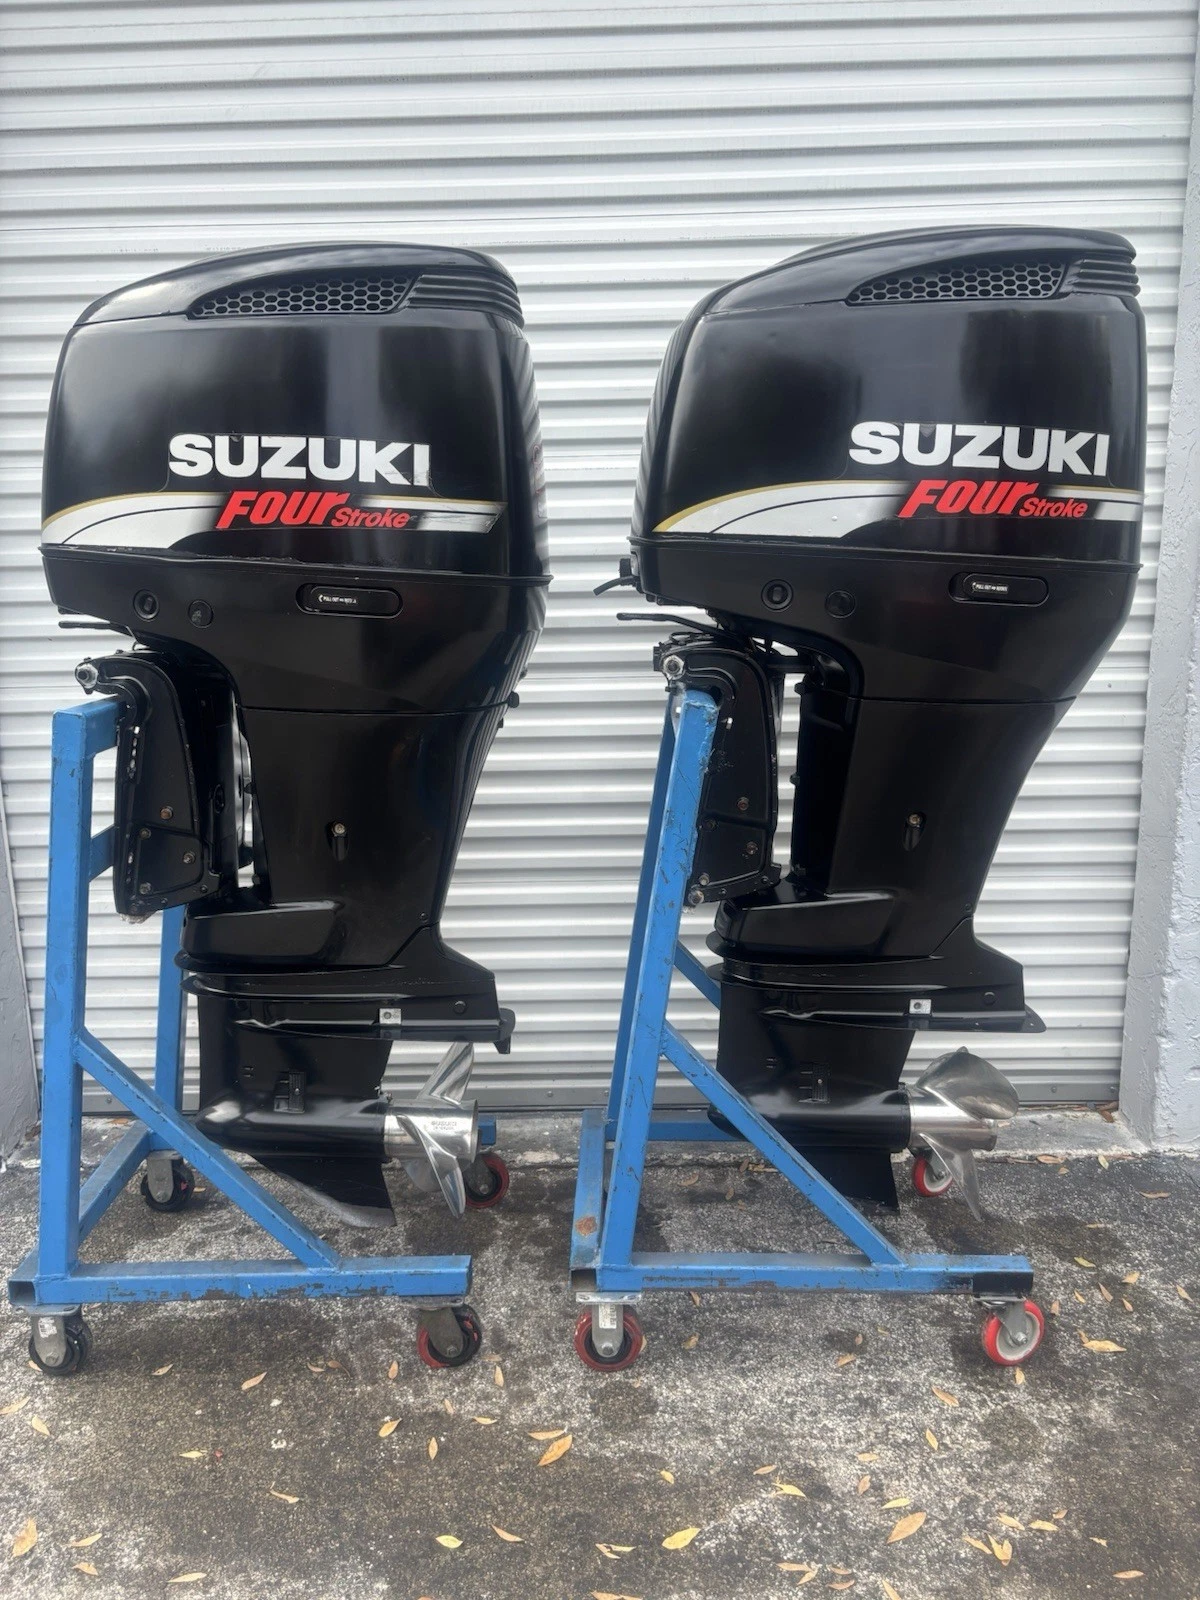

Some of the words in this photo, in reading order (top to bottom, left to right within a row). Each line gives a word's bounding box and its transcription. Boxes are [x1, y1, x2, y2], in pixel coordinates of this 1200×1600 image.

[168, 433, 430, 487] SUZUKI
[849, 421, 1110, 477] SUZUKI
[331, 506, 410, 528] Stroke
[1019, 497, 1088, 518] Stroke
